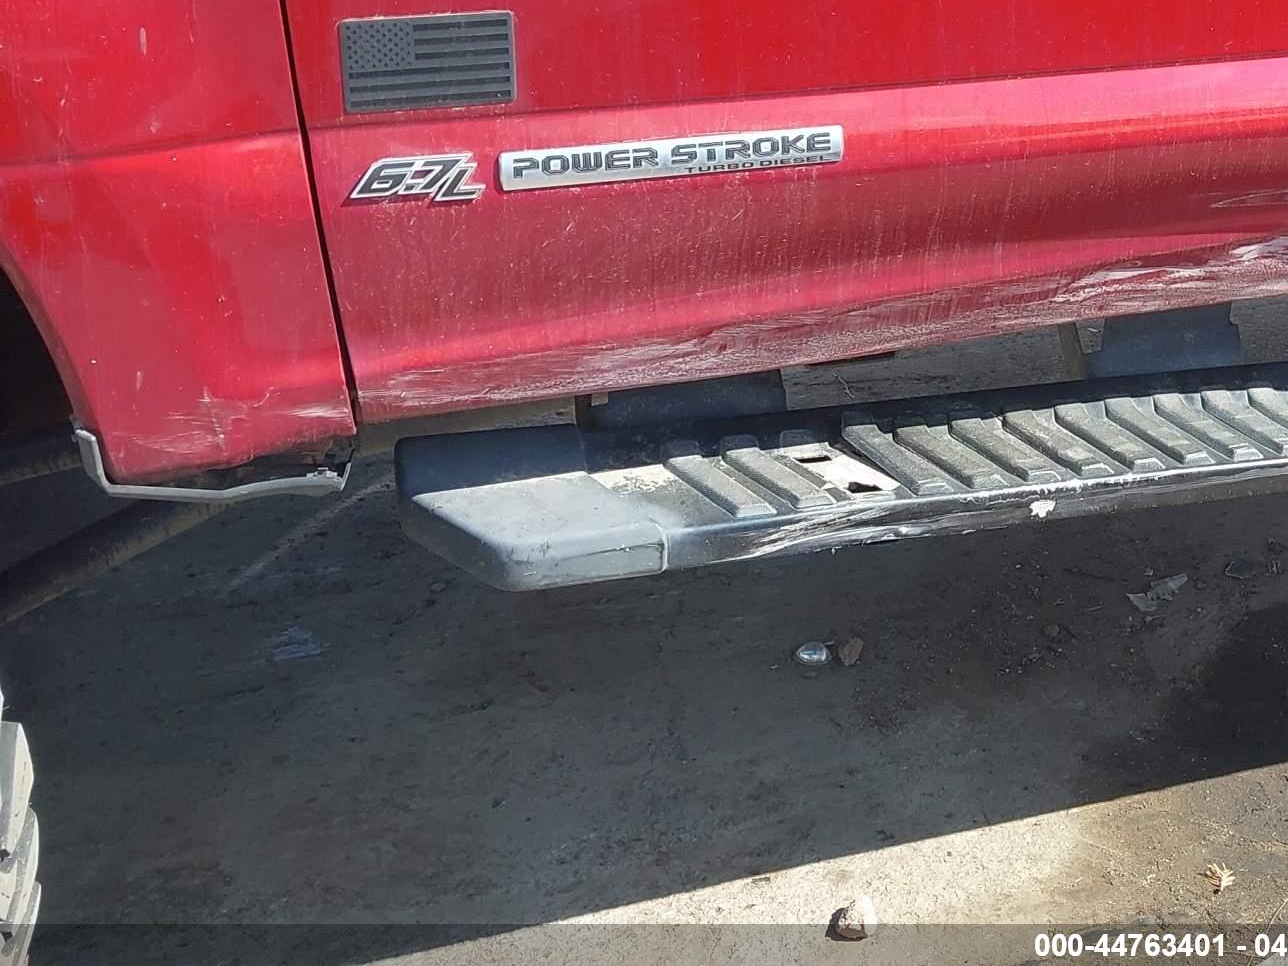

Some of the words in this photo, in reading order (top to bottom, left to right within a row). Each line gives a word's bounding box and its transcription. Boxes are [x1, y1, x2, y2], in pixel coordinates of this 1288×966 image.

[351, 153, 486, 202] 6.7L
[513, 147, 659, 178] POWER
[671, 132, 831, 165] STROKE
[686, 161, 755, 173] TURBO
[759, 154, 831, 167] DIESEL
